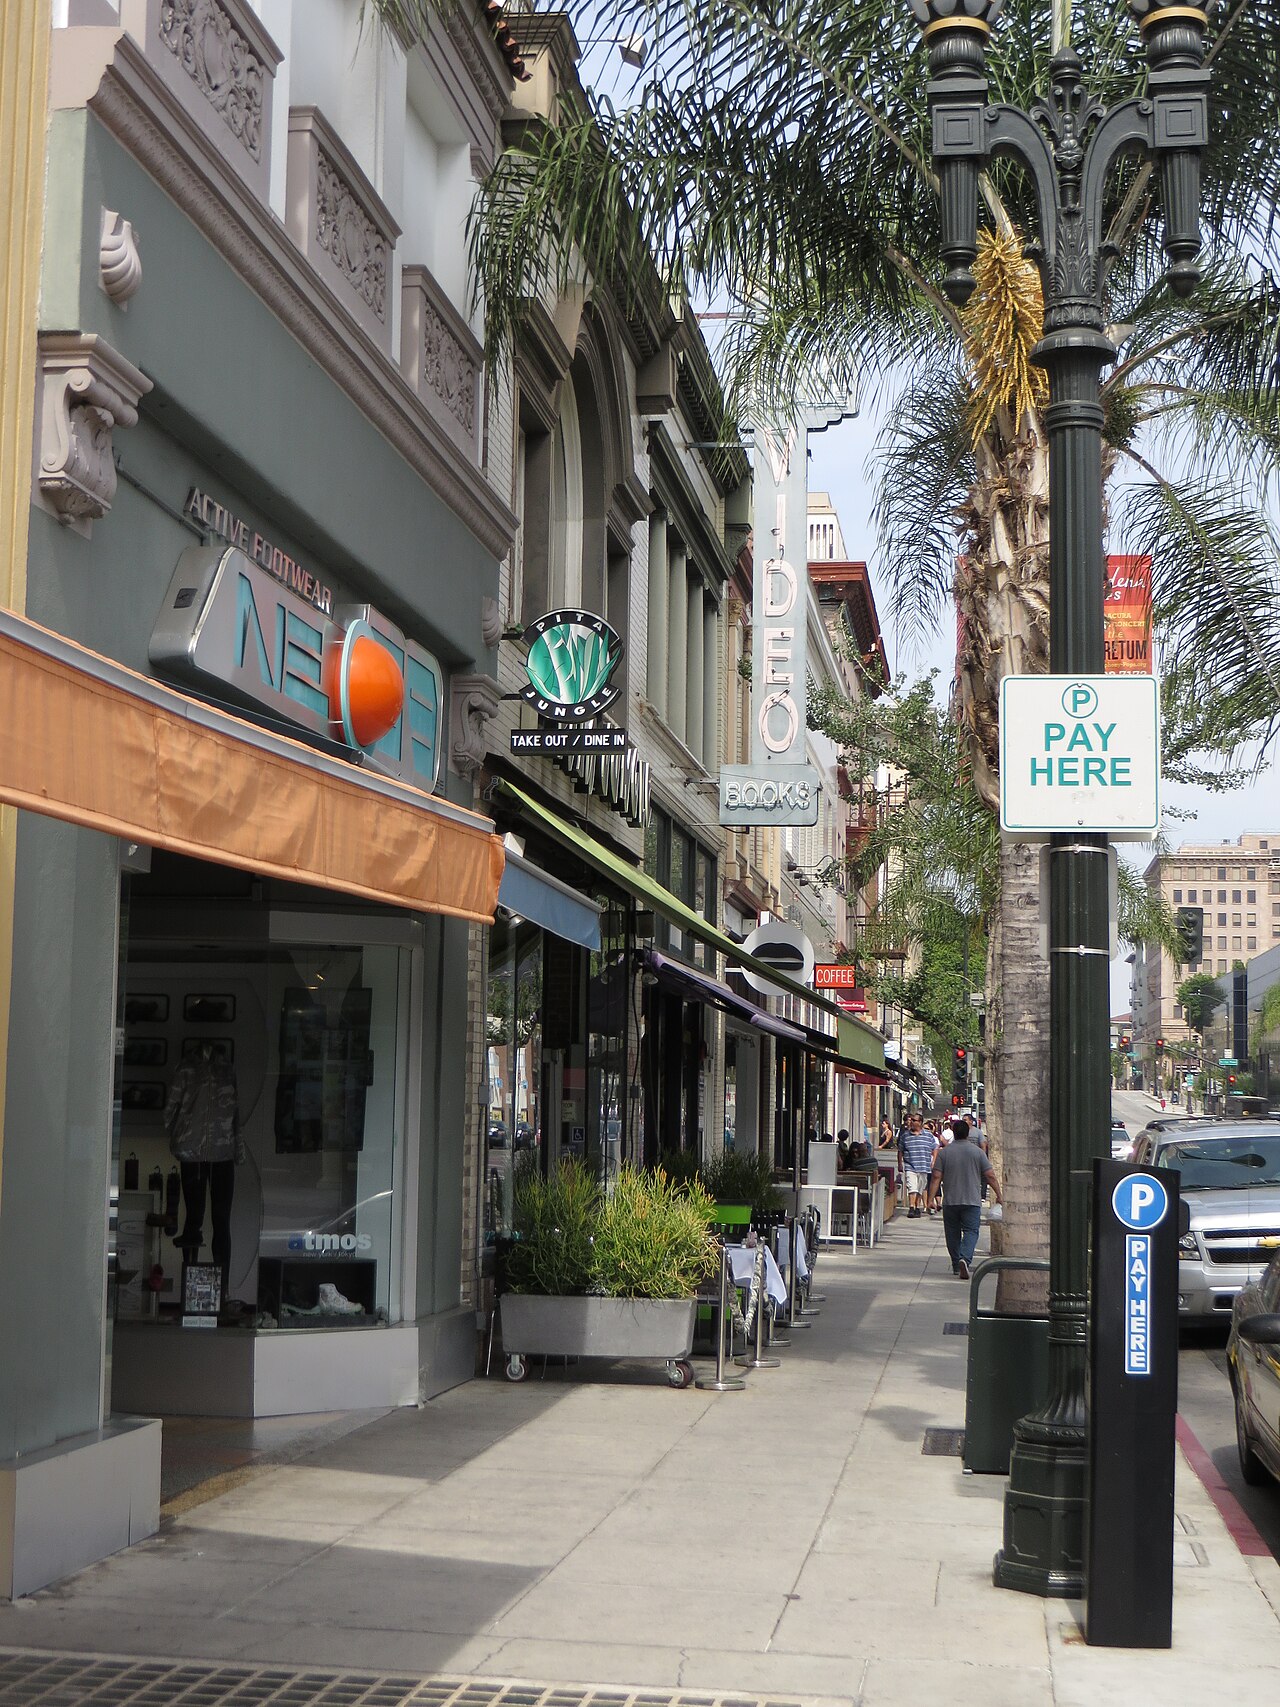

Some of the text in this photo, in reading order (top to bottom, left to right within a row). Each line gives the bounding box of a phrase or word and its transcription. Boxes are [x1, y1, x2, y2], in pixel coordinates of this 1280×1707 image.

[185, 487, 332, 614] ACTIVE FOOTWEAR
[757, 428, 799, 752] VIDEO
[1108, 566, 1146, 588] dena
[536, 613, 604, 632] PITA
[1104, 640, 1147, 660] RETUM
[526, 687, 612, 717] JUNGLE
[1072, 690, 1091, 712] P
[511, 734, 625, 746] TAKE OUT / DINE IN
[1044, 723, 1117, 752] PAY
[1030, 758, 1132, 786] HERE
[725, 780, 811, 811] BOOKS
[816, 968, 854, 984] COFFEE
[1130, 1183, 1155, 1221] P
[288, 1232, 372, 1251] atmos
[1130, 1241, 1147, 1292] PAY
[1130, 1299, 1147, 1368] HERE
